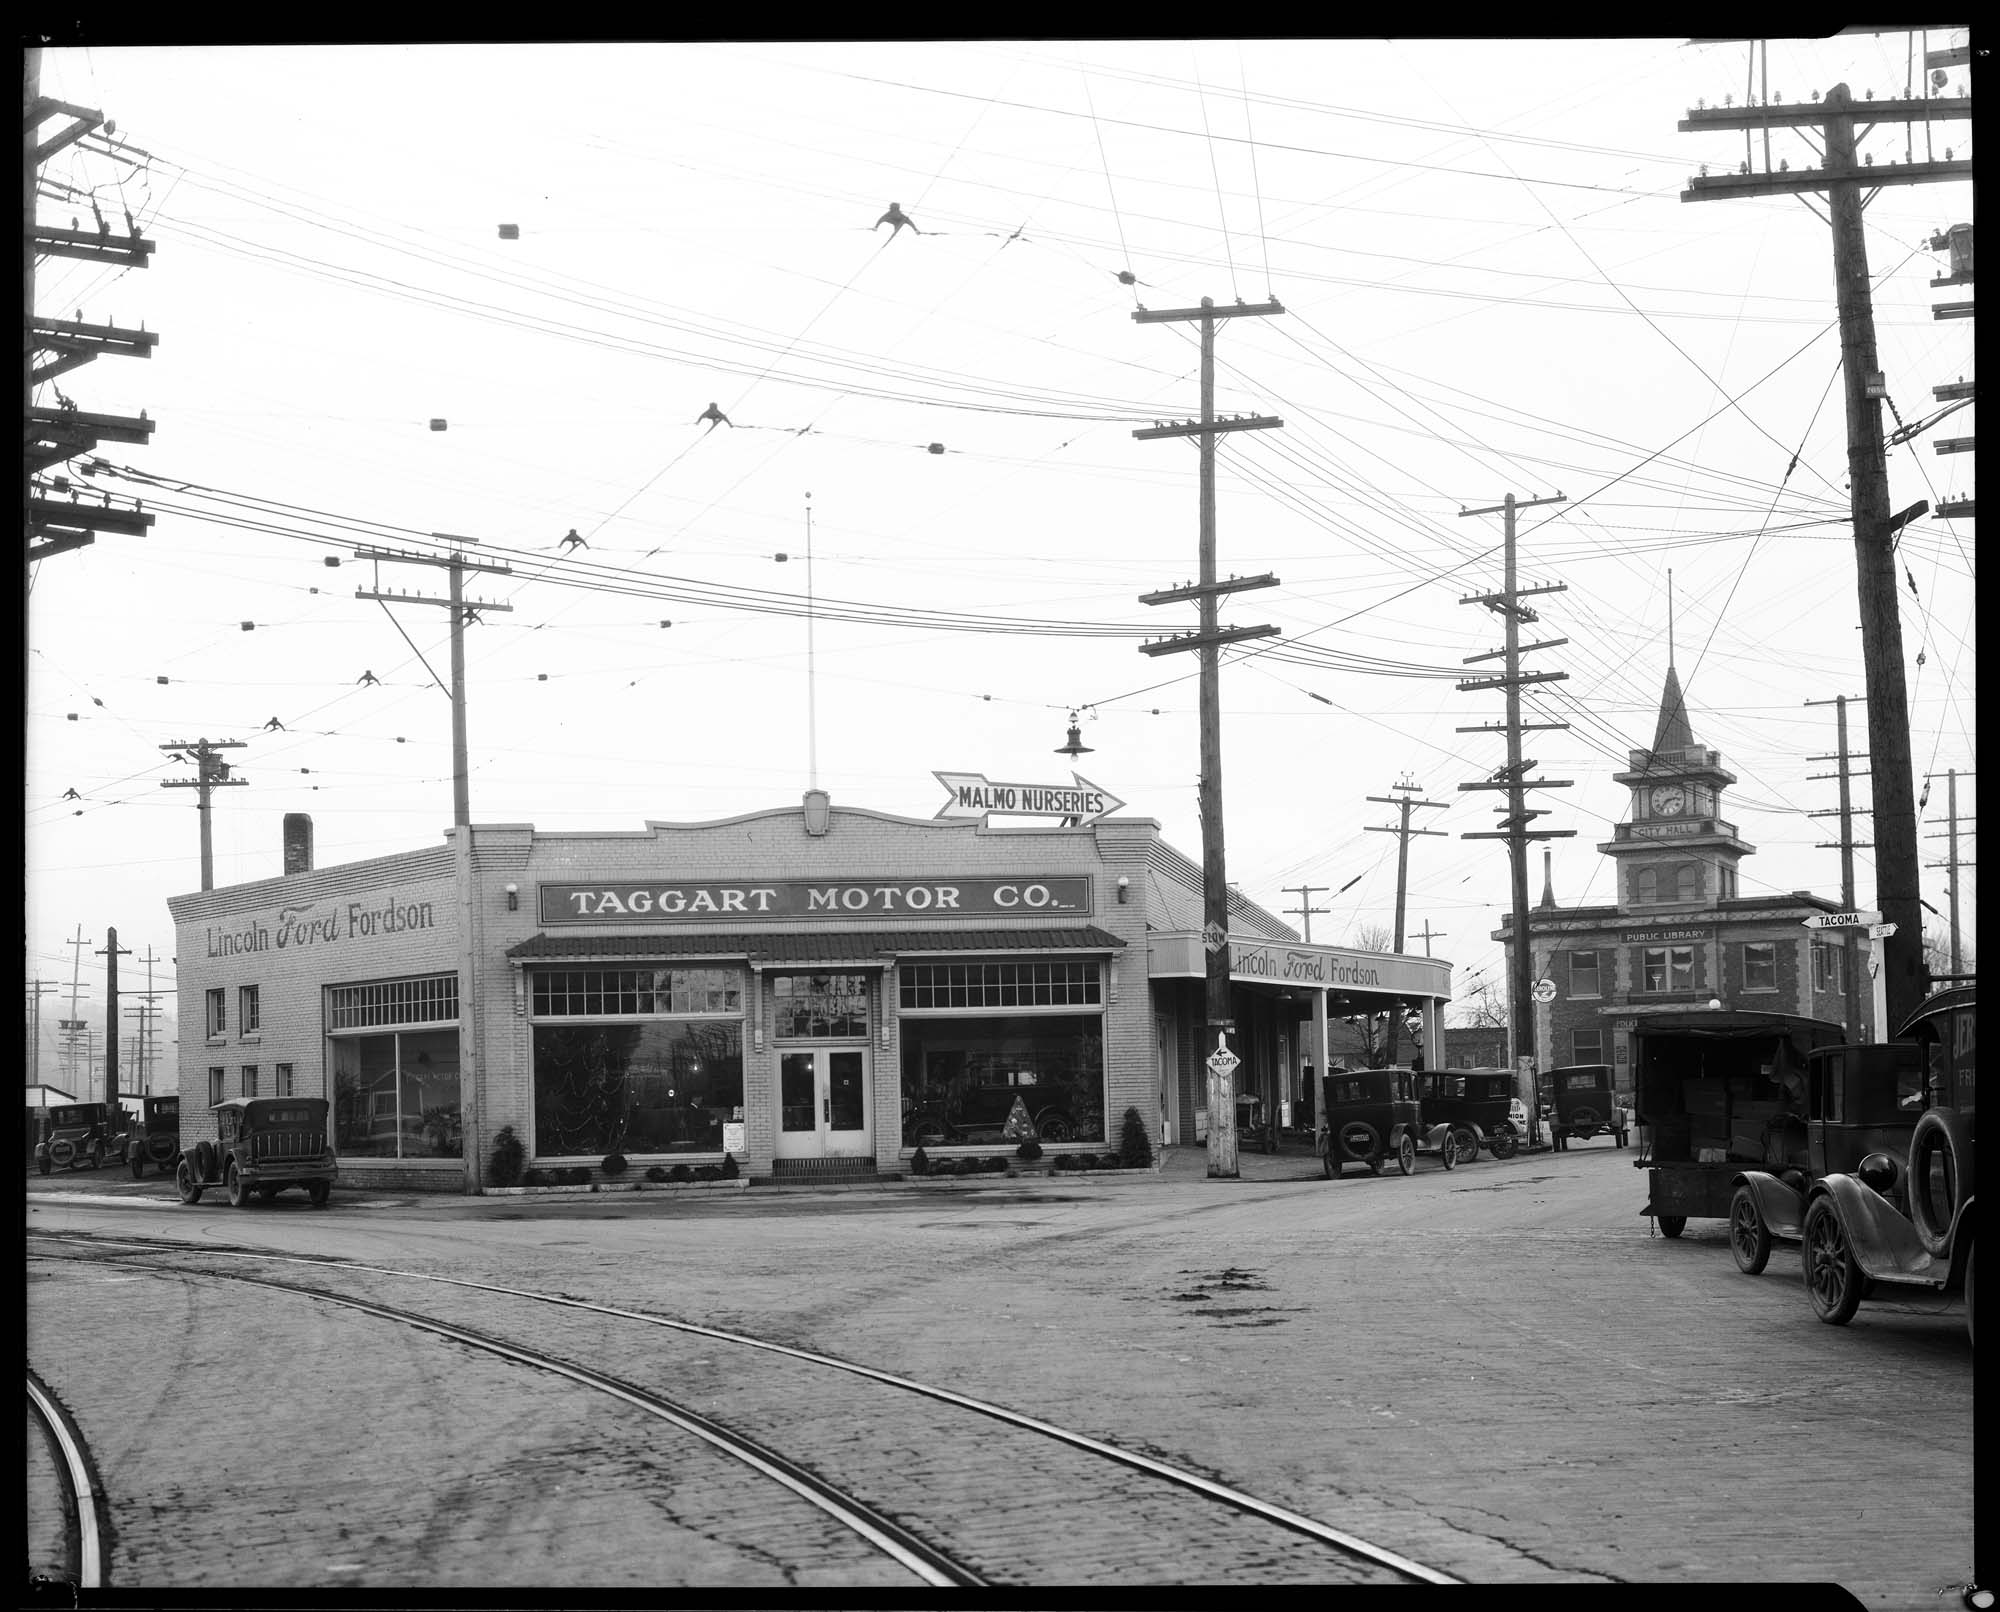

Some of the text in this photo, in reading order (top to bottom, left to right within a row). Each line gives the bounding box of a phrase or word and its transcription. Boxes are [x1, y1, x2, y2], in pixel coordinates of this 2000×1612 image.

[959, 786, 1104, 813] MALMO NURSERIES
[1666, 824, 1693, 835] HALL
[570, 884, 1059, 914] TAGGART MOTOR CO.
[207, 897, 434, 958] Lincoln Ford Fordson
[1819, 914, 1860, 926] TACOMA
[1202, 931, 1226, 944] SLOW
[1626, 930, 1705, 942] PUBLIC LIBRARY
[1229, 946, 1380, 986] Lincoln Ford Fordson
[1953, 1013, 1976, 1060] JER
[1211, 1056, 1238, 1067] TACOMA
